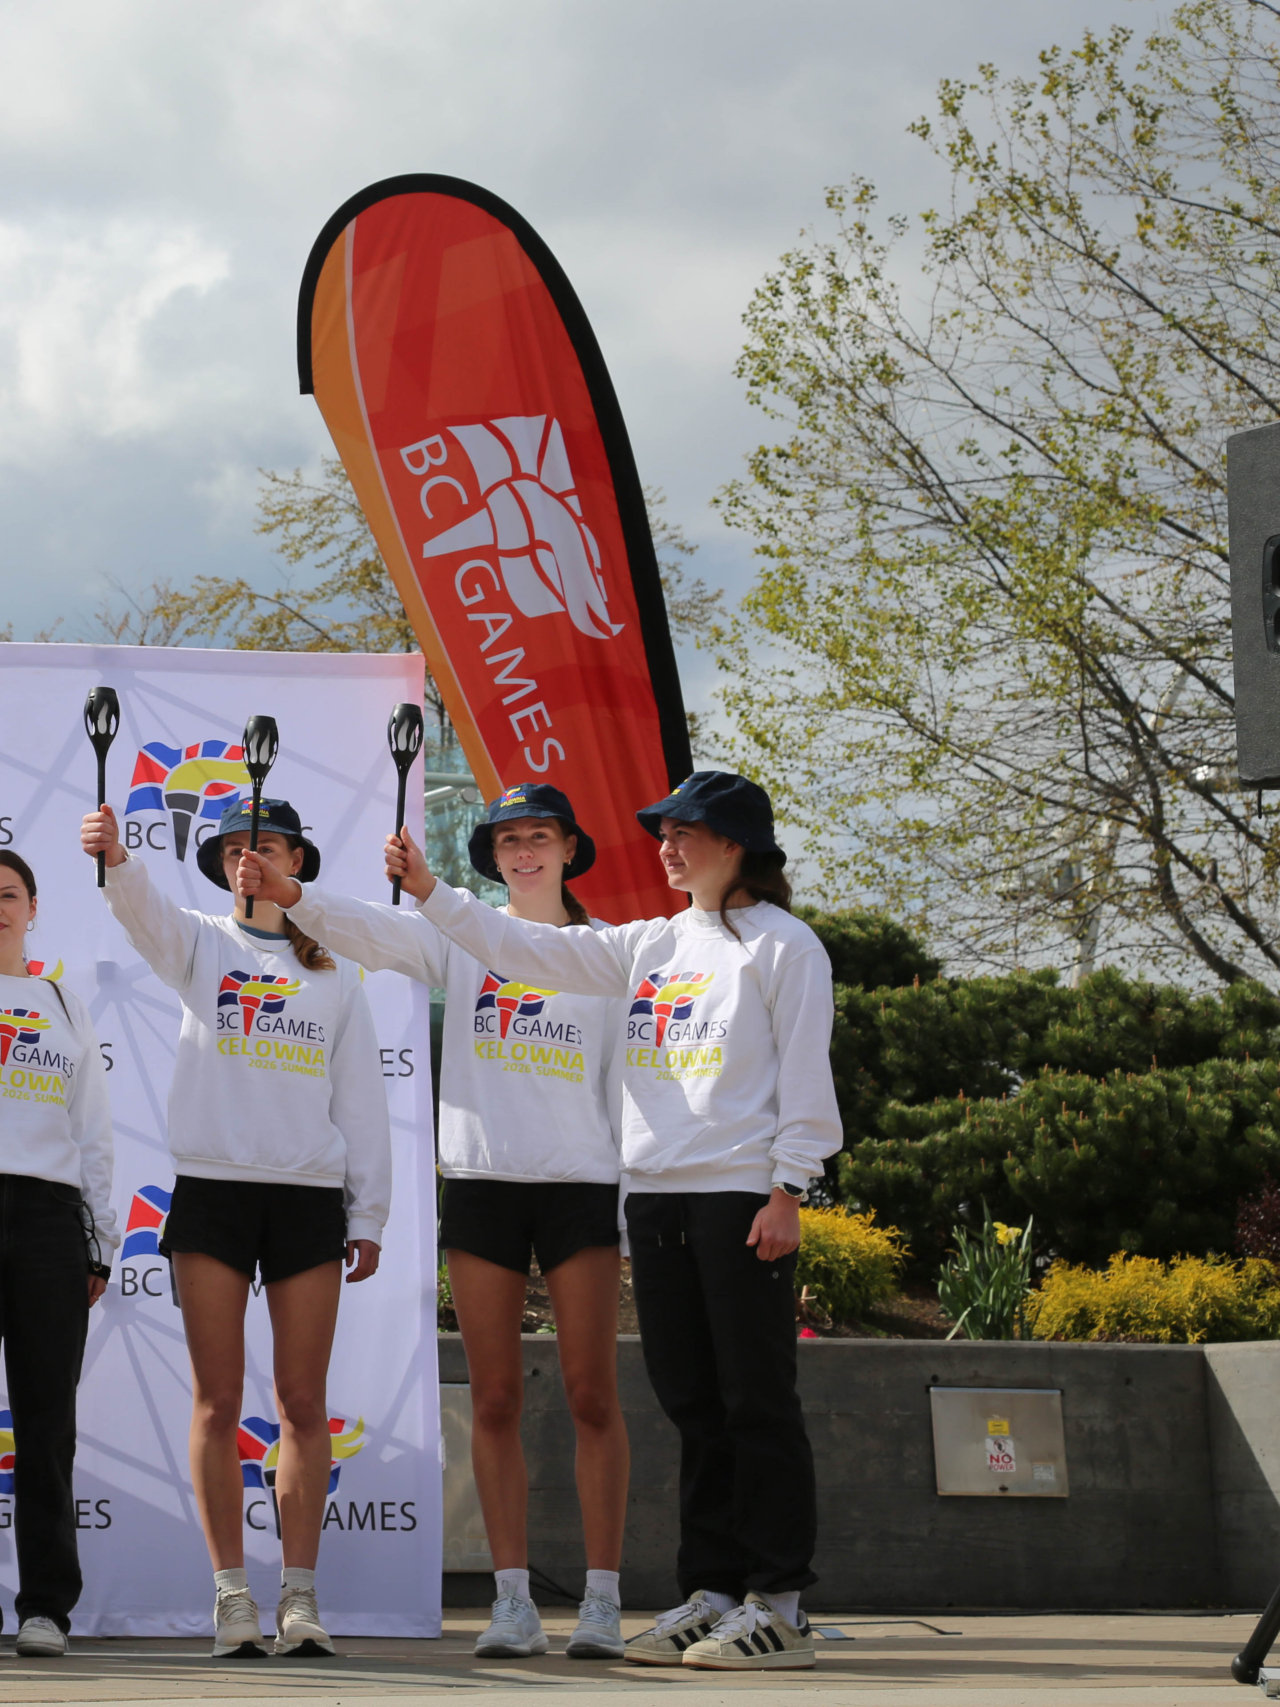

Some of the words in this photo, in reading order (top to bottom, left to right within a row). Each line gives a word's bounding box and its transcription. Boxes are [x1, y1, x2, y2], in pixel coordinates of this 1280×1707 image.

[399, 434, 469, 520] BC
[454, 559, 565, 773] GAMES
[125, 821, 167, 850] BC
[256, 1015, 325, 1042] GAMES
[474, 1015, 496, 1033] BC
[627, 1021, 652, 1040] BC
[667, 1020, 728, 1041] GAMES
[12, 1045, 75, 1079] GAMES
[474, 1039, 585, 1072] KELOWNA
[626, 1047, 723, 1068] KELOWNA
[248, 1058, 277, 1070] 2026
[281, 1061, 326, 1078] SUMMER
[503, 1062, 532, 1073] 2026
[535, 1066, 584, 1083] SUMMER
[655, 1070, 682, 1080] 2026
[2, 1088, 30, 1101] 2026
[121, 1267, 163, 1296] BC
[989, 1454, 1012, 1464] NO
[246, 1500, 267, 1530] C
[321, 1501, 417, 1531] AMES
